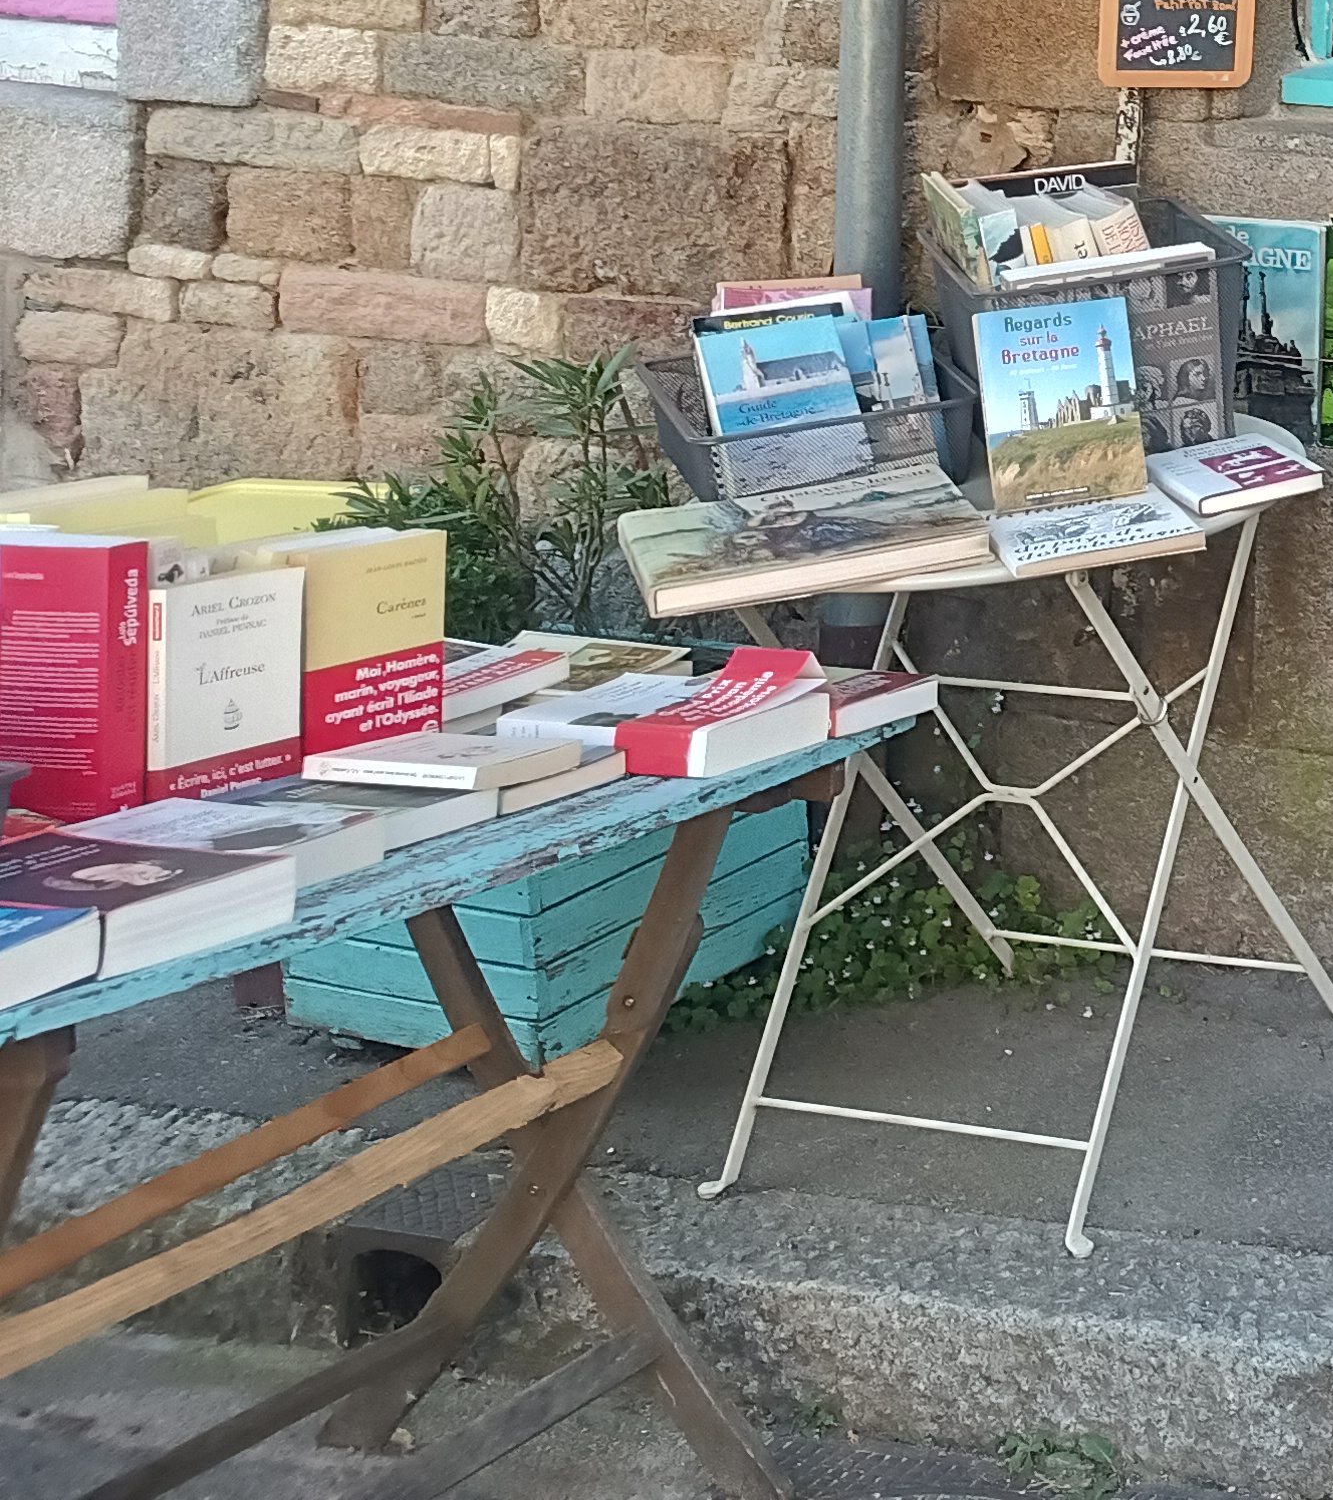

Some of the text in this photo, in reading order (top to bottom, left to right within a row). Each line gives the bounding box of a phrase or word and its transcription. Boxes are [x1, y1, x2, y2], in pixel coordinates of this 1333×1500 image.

[1034, 174, 1086, 194] DAVID
[724, 316, 773, 330] Bertrand
[1004, 312, 1072, 333] Regards
[1134, 316, 1213, 341] APHAEL
[1019, 331, 1058, 347] sur la
[1002, 345, 1080, 366] Bretagne
[228, 592, 277, 610] CROZON
[325, 705, 365, 725] ayant
[359, 719, 374, 732] et
